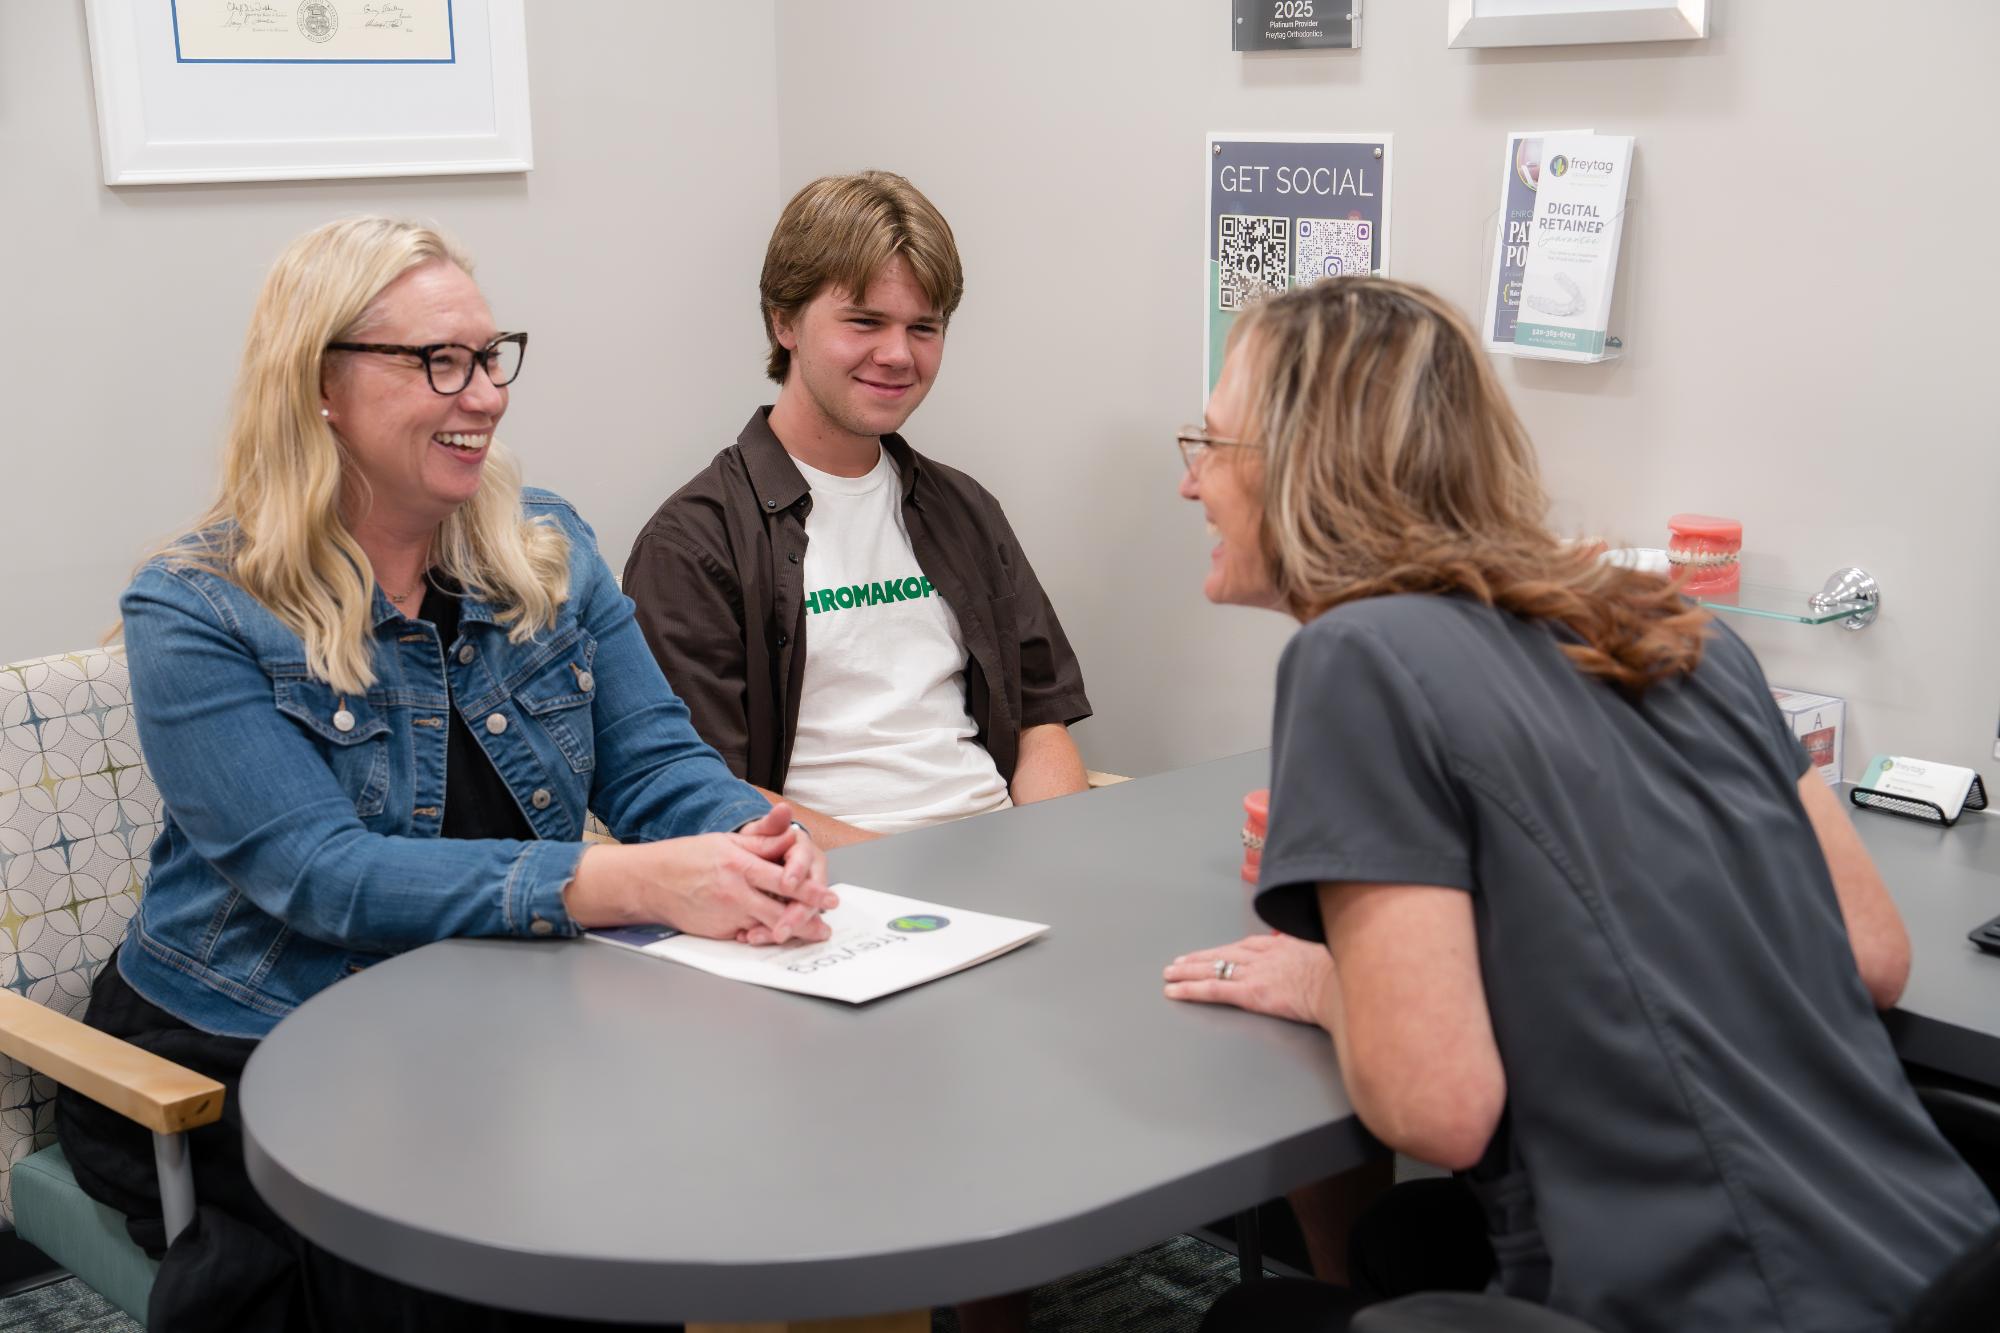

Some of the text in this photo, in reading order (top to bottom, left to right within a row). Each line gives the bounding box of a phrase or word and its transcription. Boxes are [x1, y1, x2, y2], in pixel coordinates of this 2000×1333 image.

[1274, 1, 1314, 19] 2025
[1295, 20, 1318, 28] Provider
[1265, 30, 1323, 39] Freytag Orthodontics
[1570, 157, 1614, 174] freytag
[1220, 165, 1374, 197] GET SOCIAL
[1547, 202, 1600, 218] DIGITAL
[804, 575, 943, 616] HROMAKOP
[1814, 712, 1823, 730] A
